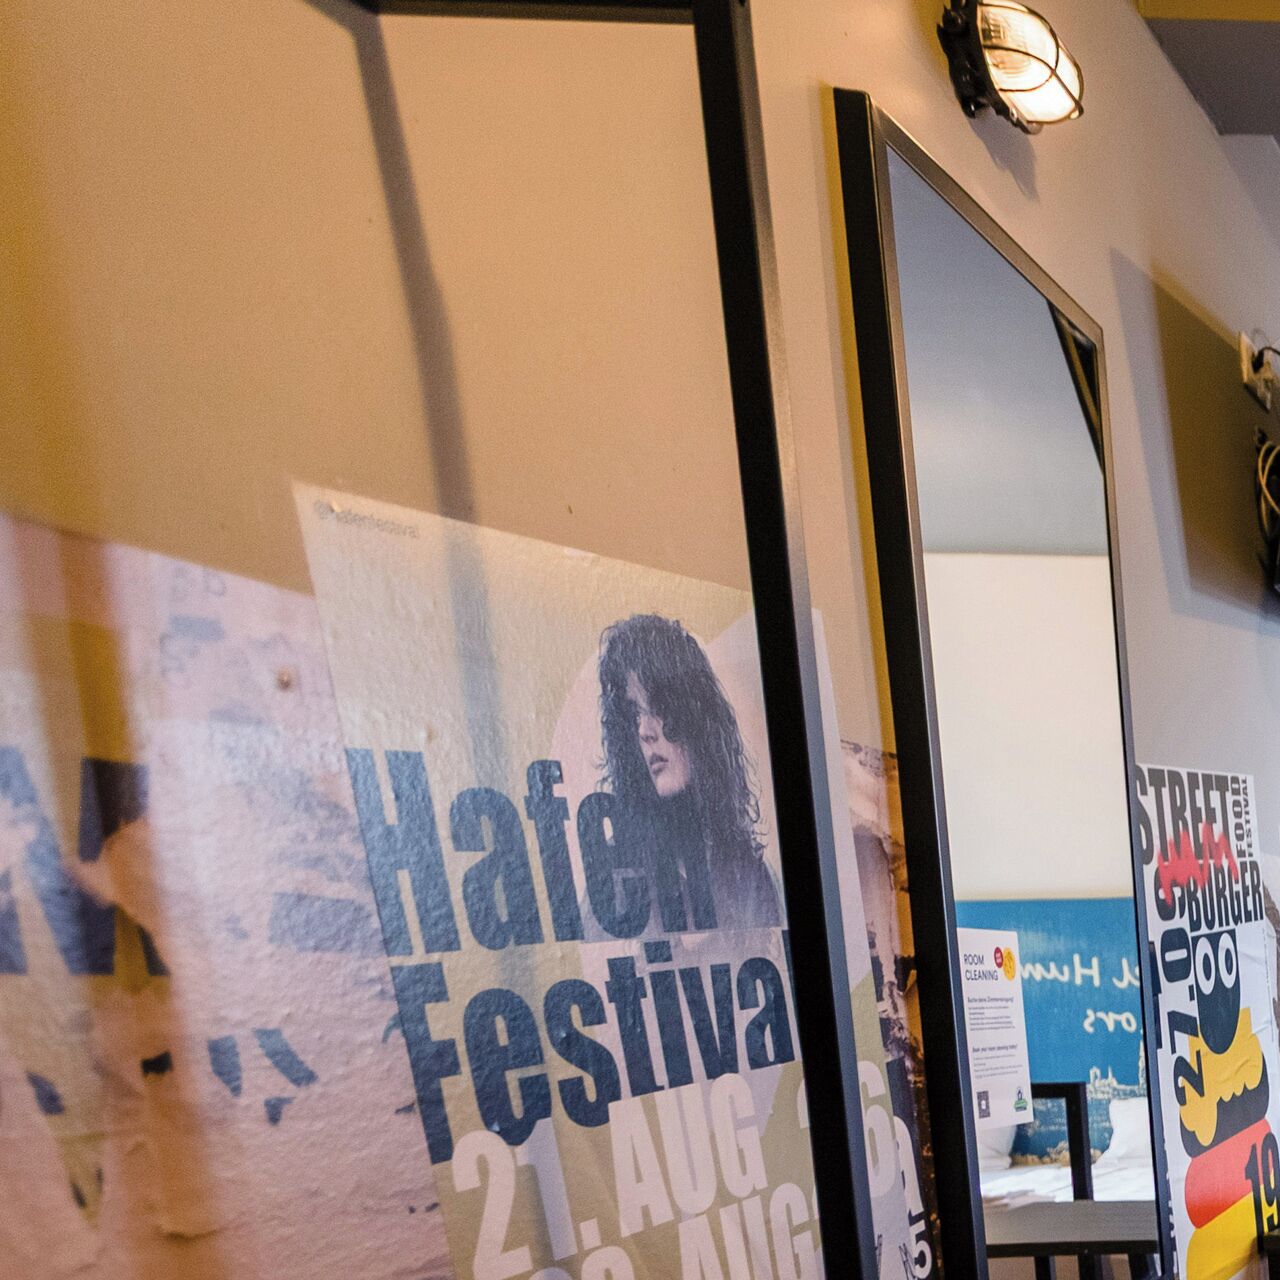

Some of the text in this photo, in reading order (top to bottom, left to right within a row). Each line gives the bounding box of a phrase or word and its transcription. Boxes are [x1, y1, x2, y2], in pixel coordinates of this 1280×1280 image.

[345, 747, 716, 956] Hafen
[1135, 764, 1230, 865] STREET
[1230, 775, 1247, 859] FOOD
[1241, 776, 1254, 858] FESTIVAL
[1186, 860, 1264, 932] BURGER
[963, 953, 985, 966] ROOM
[964, 969, 999, 982] CLEANING
[608, 1072, 771, 1237] AUG
